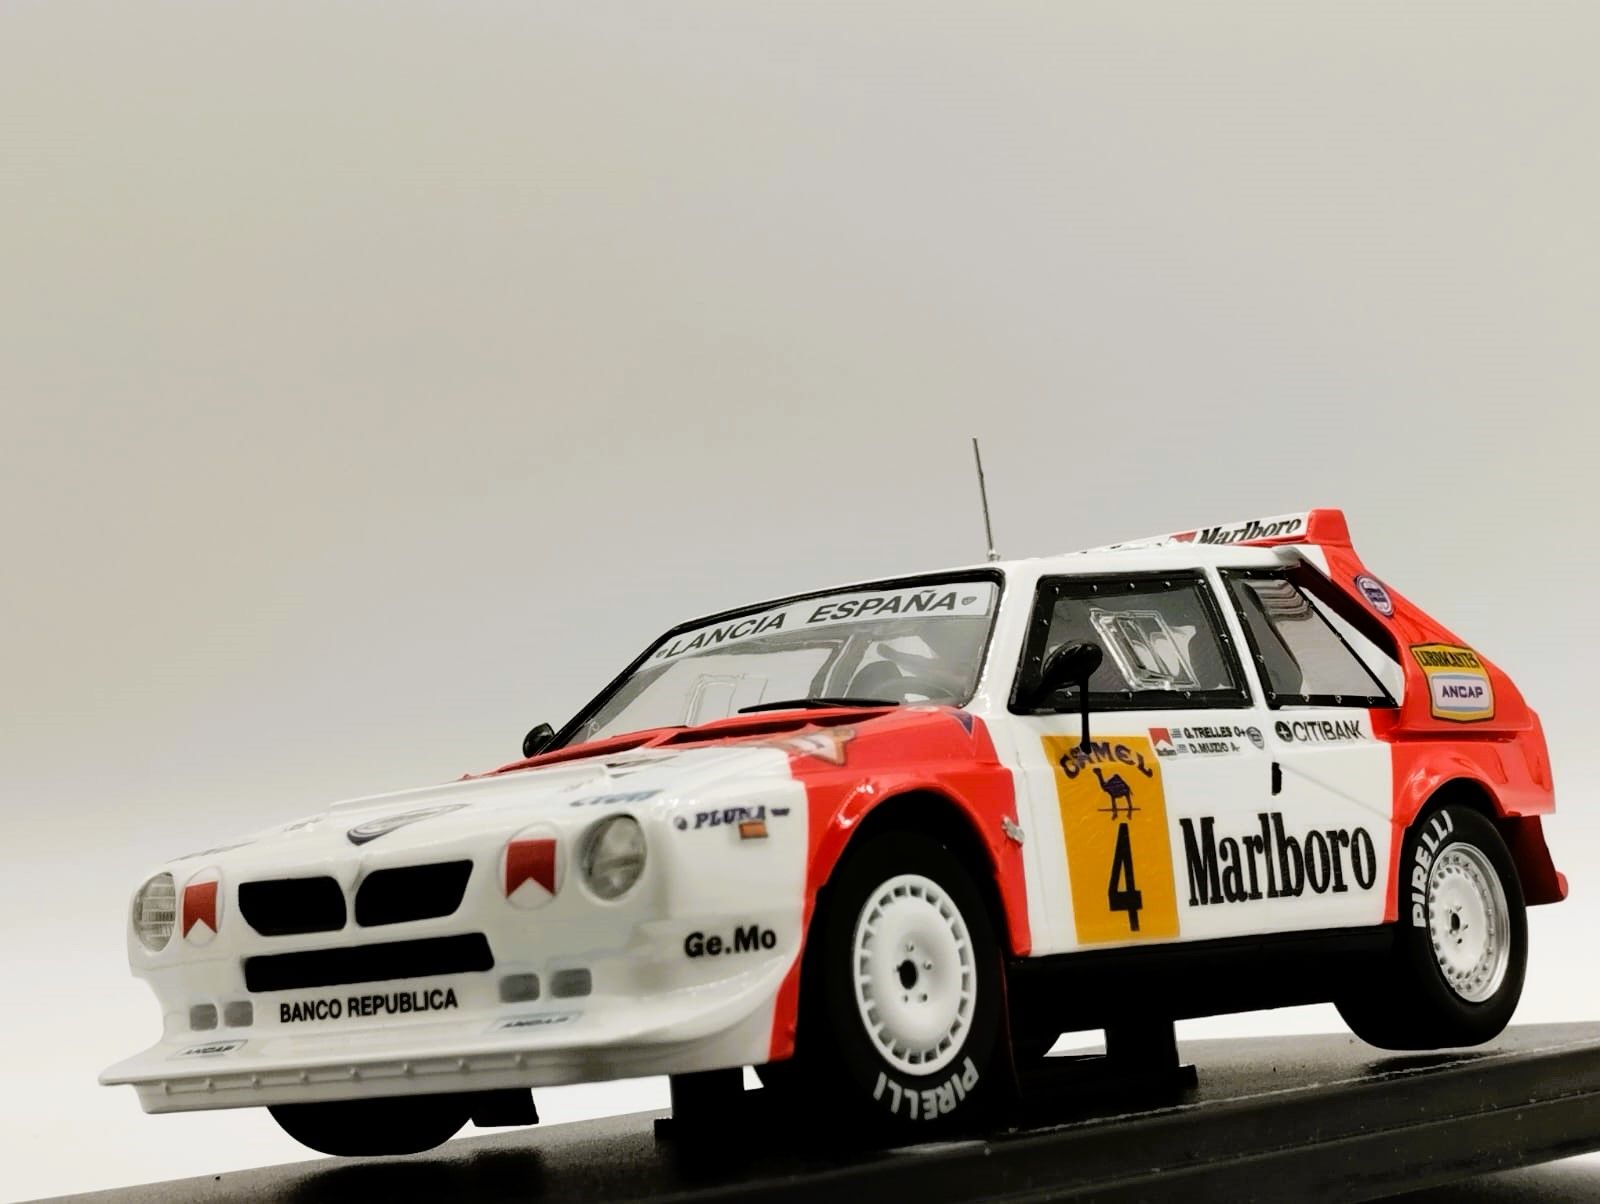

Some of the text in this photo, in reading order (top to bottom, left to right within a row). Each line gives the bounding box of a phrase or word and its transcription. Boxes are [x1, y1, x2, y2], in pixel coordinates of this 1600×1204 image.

[1198, 518, 1302, 545] Marlboro
[664, 590, 956, 660] LANCIA ESPAÑA
[1442, 685, 1483, 698] ANCAP
[1292, 720, 1366, 742] CITIBANK
[693, 805, 766, 829] PLUNA
[1108, 823, 1143, 931] 4
[1179, 812, 1377, 907] Marlboro
[1411, 809, 1453, 928] PIRELLI
[684, 924, 777, 958] Ge.Mo
[280, 987, 458, 1023] BANCO REPUBLICA
[872, 1056, 979, 1120] PIRELLI
